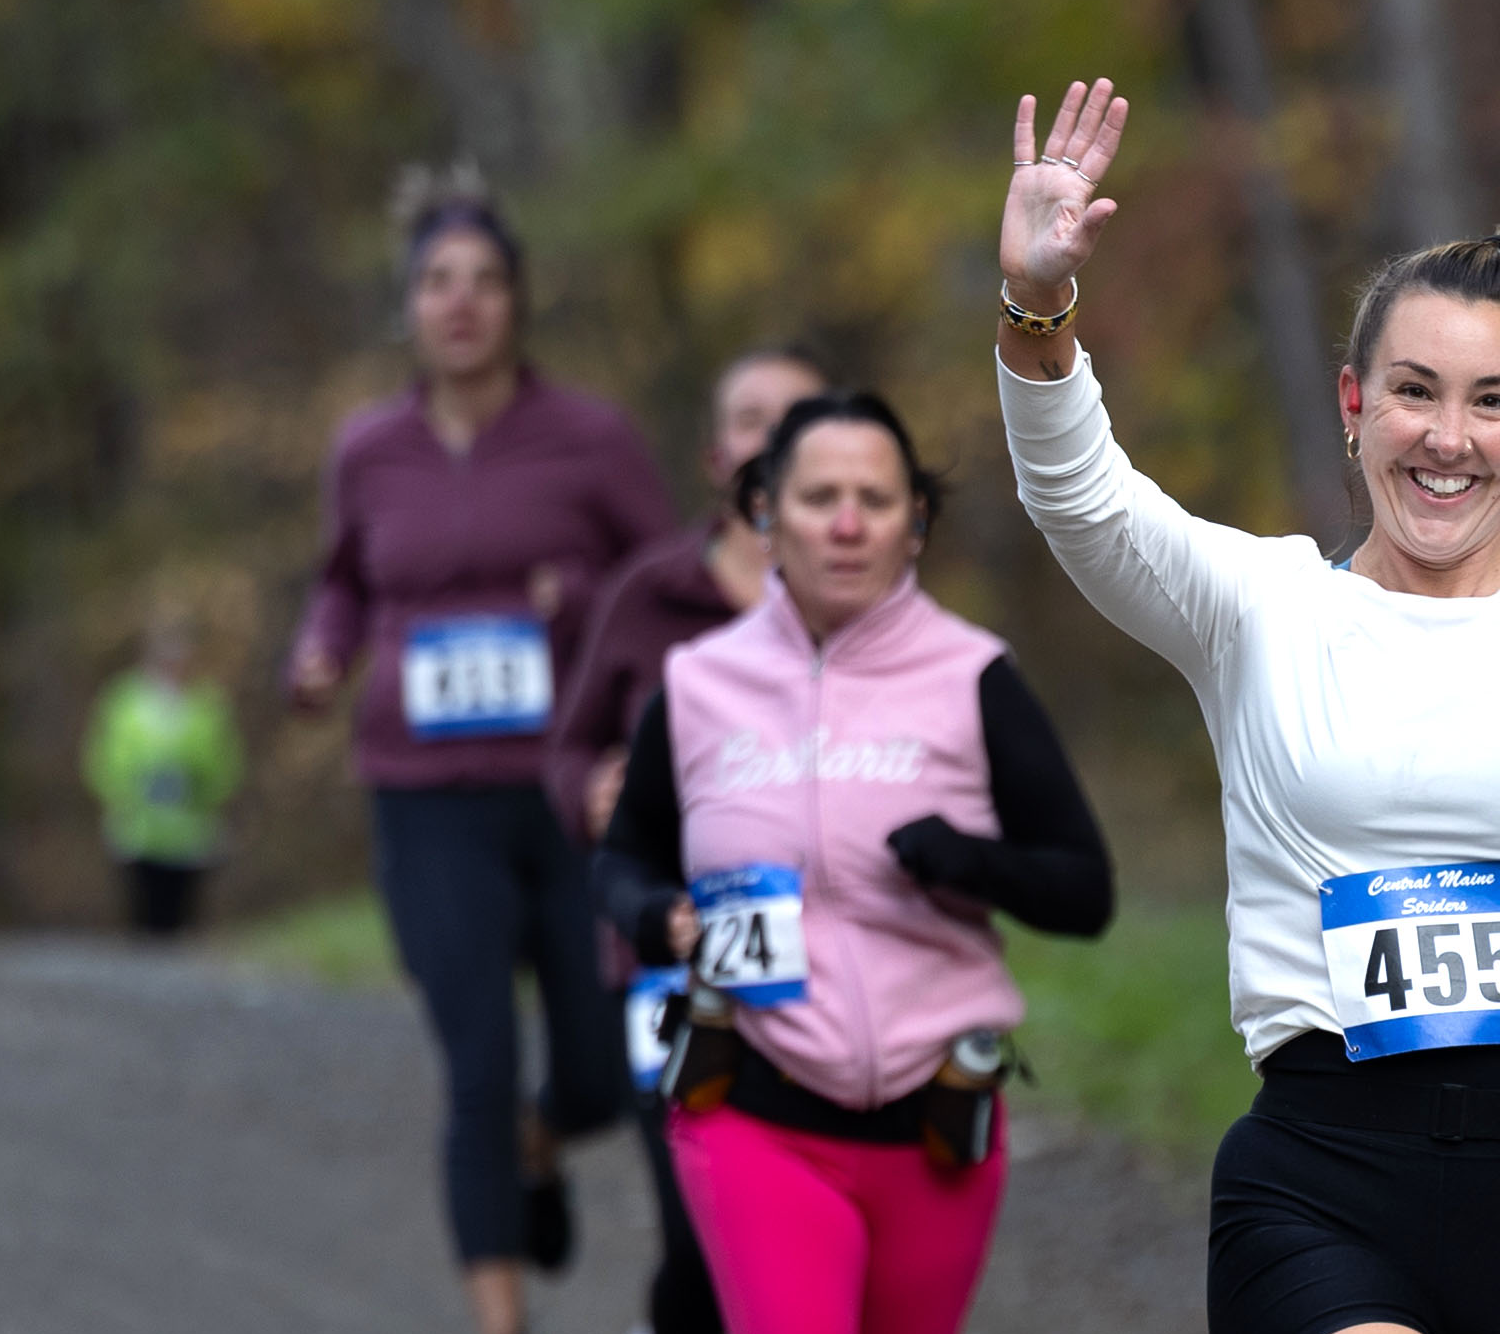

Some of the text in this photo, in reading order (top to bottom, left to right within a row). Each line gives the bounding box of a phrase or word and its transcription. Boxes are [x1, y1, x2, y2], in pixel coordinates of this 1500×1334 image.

[1367, 869, 1495, 896] Central Maine
[1401, 897, 1468, 915] Striders
